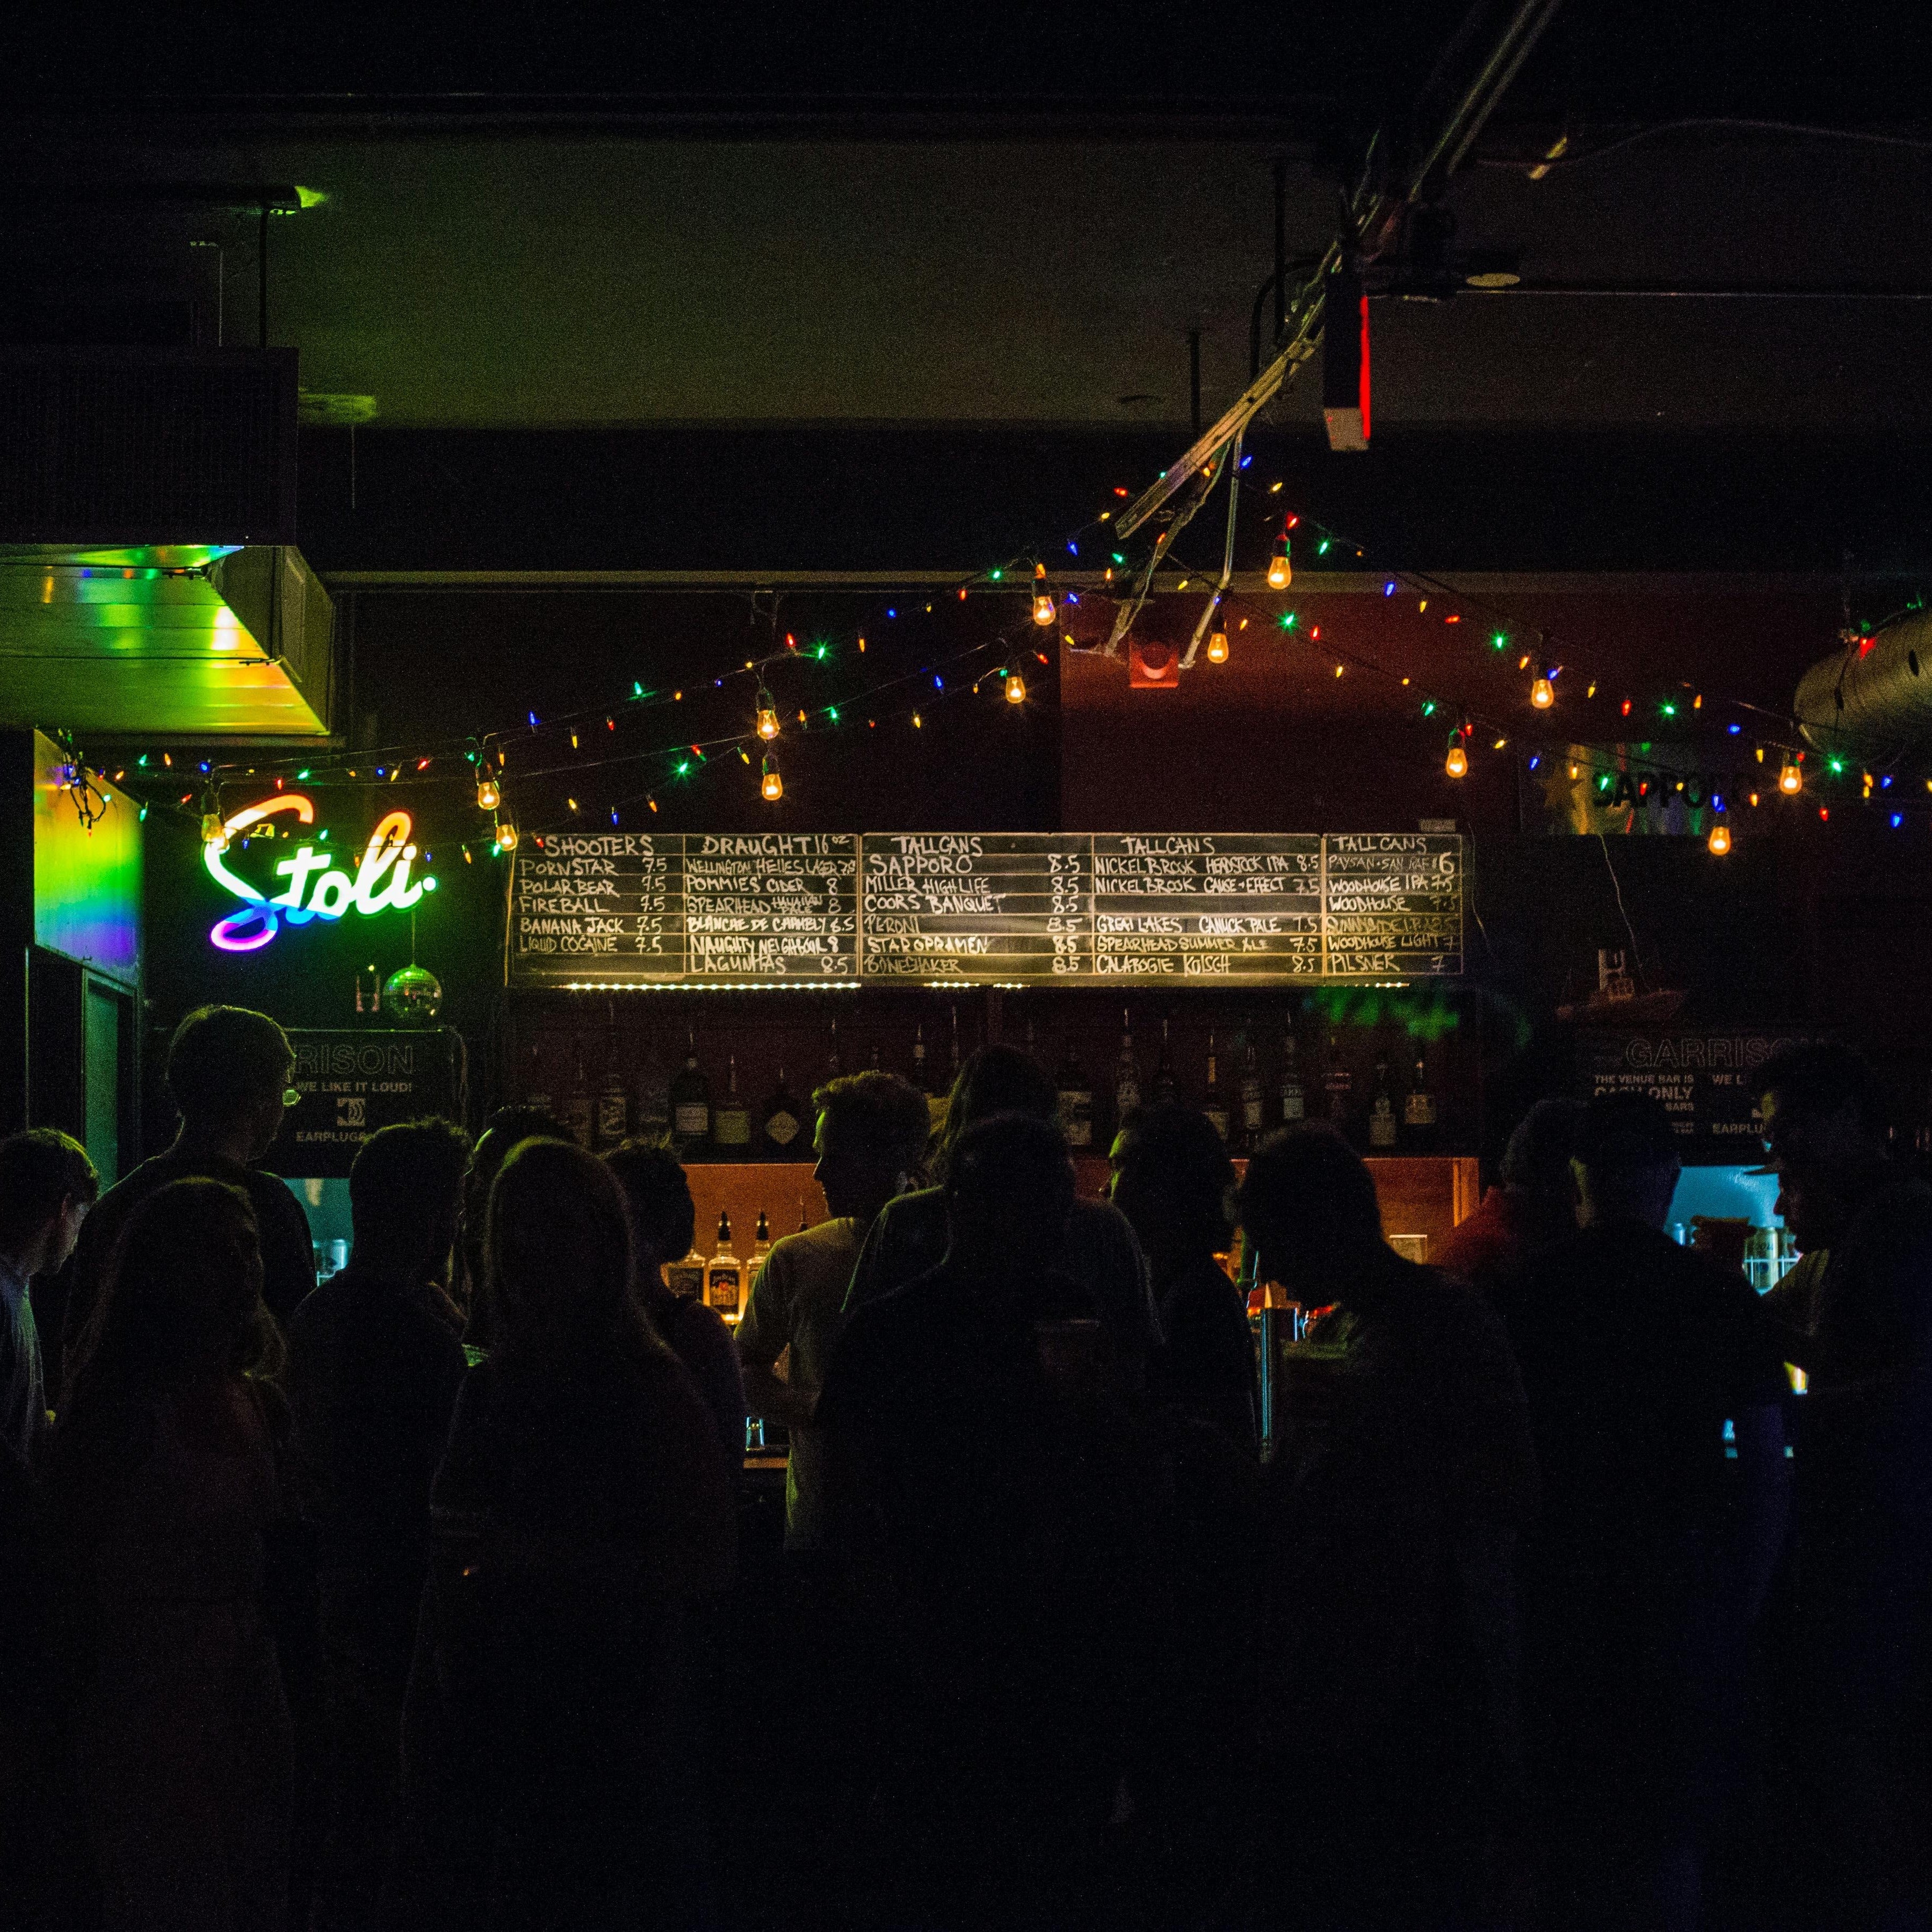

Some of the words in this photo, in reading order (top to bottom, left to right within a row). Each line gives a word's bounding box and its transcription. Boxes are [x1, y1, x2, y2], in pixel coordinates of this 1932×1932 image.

[544, 835, 655, 857] SHOOTERS
[701, 835, 812, 856] DRAUGHT
[815, 834, 829, 855] 16
[1333, 835, 1377, 852] TALL
[1380, 836, 1427, 855] CANS
[642, 857, 668, 873] 7.5
[686, 858, 752, 875] WELLINGTON
[870, 853, 973, 875] SAPPORO
[1048, 853, 1080, 873] 8.5
[1267, 856, 1289, 873] IPA
[1297, 854, 1318, 872] 8.5
[519, 878, 576, 896] POLAR
[574, 878, 620, 898] BEAR
[641, 876, 667, 892] 7.5
[766, 878, 812, 896] CIDER
[827, 878, 837, 895] 8
[865, 875, 922, 895] MILLER
[1051, 876, 1079, 894] 8.5
[1204, 876, 1236, 894] CAUSE
[1246, 876, 1286, 894] EFFECT
[1293, 878, 1320, 895] 7.5
[1329, 875, 1401, 894] WOODHOUSE
[1406, 874, 1428, 891] IPA
[519, 896, 610, 913] FIREBALL
[640, 895, 665, 912] 7.5
[687, 896, 771, 914] SPEARHEAD
[828, 898, 841, 914] 8
[864, 894, 920, 912] COORS
[925, 894, 1006, 914] BANQUET
[1052, 895, 1079, 913] 8.5
[1329, 895, 1410, 912] WOODHOUSE
[520, 917, 582, 935] BANANA
[584, 917, 624, 934] JACK
[636, 916, 663, 936] 7.5
[687, 915, 749, 932] BLANCHE
[751, 917, 769, 931] DE
[864, 913, 920, 934] PERONI
[1047, 917, 1083, 932] 8.5
[1096, 915, 1134, 933] GREAT
[1138, 916, 1182, 933] LAKES
[1199, 915, 1246, 934] CANUCK
[1244, 916, 1282, 933] PALE
[1292, 916, 1318, 933] 7.5
[520, 935, 557, 953] LIQUID
[561, 935, 618, 954] COCAINE
[635, 936, 663, 955] 7.5
[690, 935, 755, 956] NAUGHTY
[827, 936, 838, 953] 8
[1053, 935, 1079, 954] 8.5
[1096, 936, 1178, 953] SPEARHEAD
[1178, 937, 1238, 952] SUMMER
[1290, 937, 1318, 953] 7.5
[1328, 936, 1397, 951] WOODHOUSE
[821, 956, 848, 975] 8.5
[1052, 956, 1081, 974] 8.5
[1096, 954, 1174, 974] CALABOGIE
[1292, 955, 1315, 973] 8.5
[1327, 953, 1400, 974] PILSNER
[296, 1045, 414, 1075] RISON
[322, 1082, 350, 1092] LIKE
[355, 1082, 367, 1092] IT
[371, 1082, 413, 1092] LOUD!
[1594, 1074, 1617, 1084] THE
[1618, 1074, 1655, 1084] VENUE
[1658, 1074, 1681, 1084] BAR
[1683, 1074, 1695, 1084] IS
[1712, 1074, 1732, 1084] WE
[1648, 1086, 1694, 1101] ONLY
[1712, 1123, 1764, 1134] EARPLU
